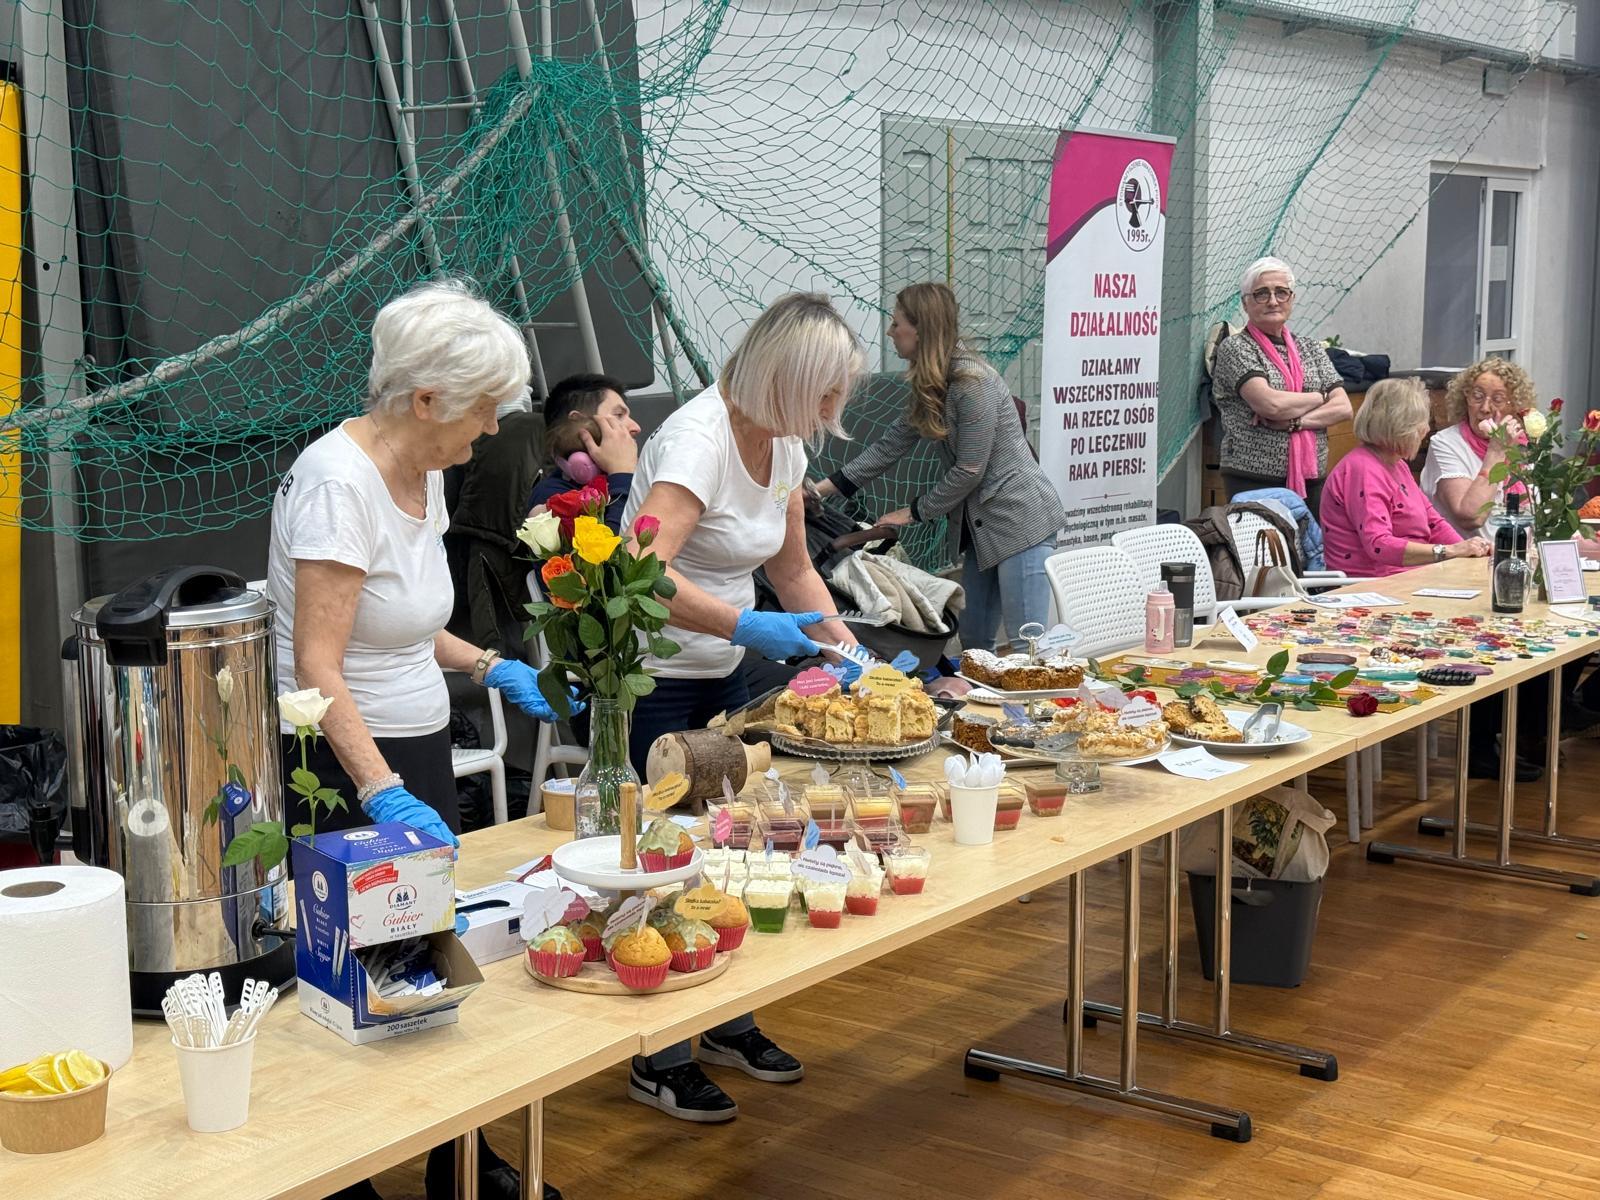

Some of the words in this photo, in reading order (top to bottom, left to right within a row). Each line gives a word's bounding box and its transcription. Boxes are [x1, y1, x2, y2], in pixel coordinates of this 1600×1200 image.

[1127, 229, 1151, 243] 1995r.
[1094, 274, 1136, 298] NASZA
[1070, 306, 1158, 337] DZIAŁALNOŚĆ
[1081, 357, 1141, 376] DZIAŁAMY
[1064, 413, 1078, 430] NA
[1082, 409, 1120, 427] RZECZ
[1124, 403, 1154, 424] OSÓB
[1071, 437, 1085, 456] PO
[1089, 432, 1146, 453] LECZENIU
[1069, 462, 1098, 481] RAKA
[1102, 457, 1146, 478] PIERSI:
[1086, 502, 1122, 515] wszechstronną
[1100, 519, 1104, 527] w
[1105, 517, 1114, 527] tym
[389, 900, 417, 909] DIAMANT
[383, 911, 424, 927] Cukier
[390, 923, 417, 933] BIAŁY
[387, 1024, 400, 1032] 200
[400, 1017, 428, 1029] saszetek
